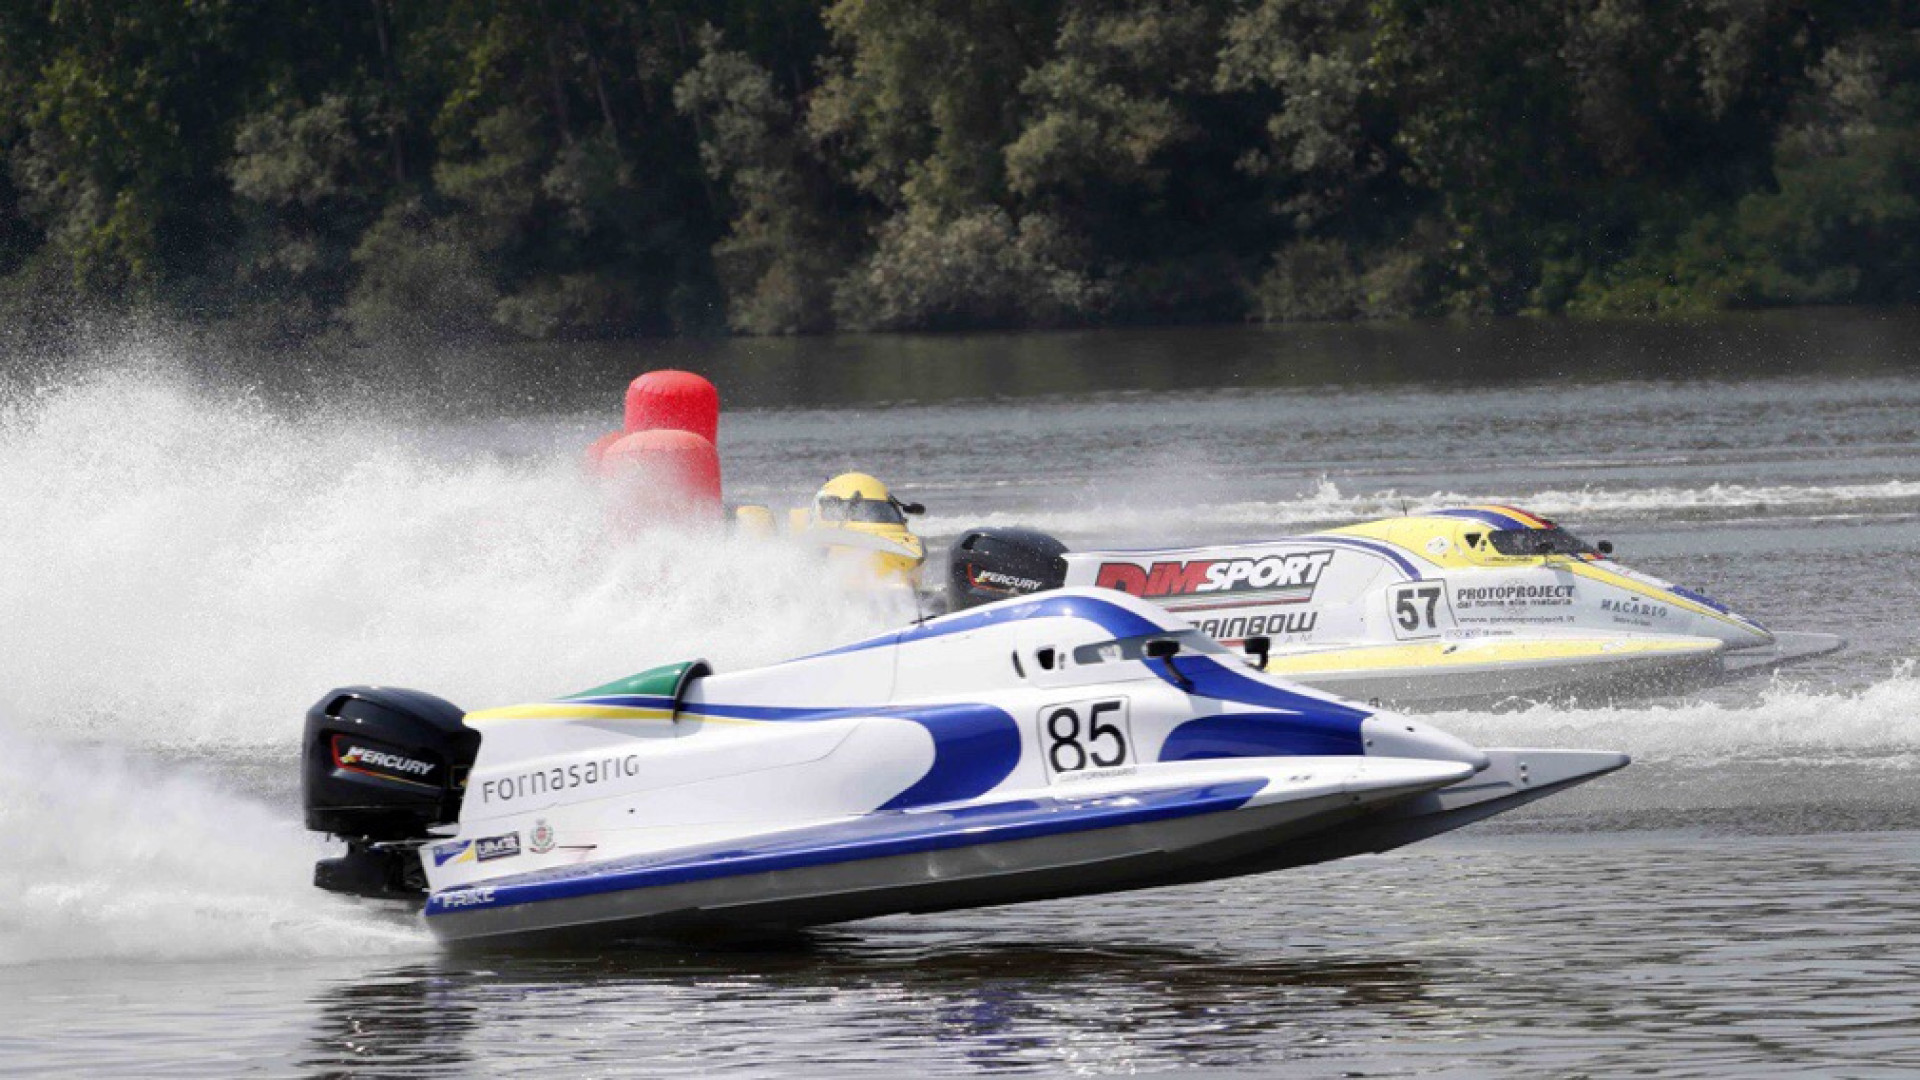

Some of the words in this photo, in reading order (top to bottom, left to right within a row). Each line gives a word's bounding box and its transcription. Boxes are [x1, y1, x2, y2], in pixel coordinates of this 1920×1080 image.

[975, 570, 1042, 591] MERCURY
[1457, 585, 1575, 600] PROTOPROJECT
[1396, 587, 1441, 631] 57
[1601, 599, 1668, 617] MACARIO
[1047, 700, 1126, 774] 85
[340, 745, 436, 775] MERCURY
